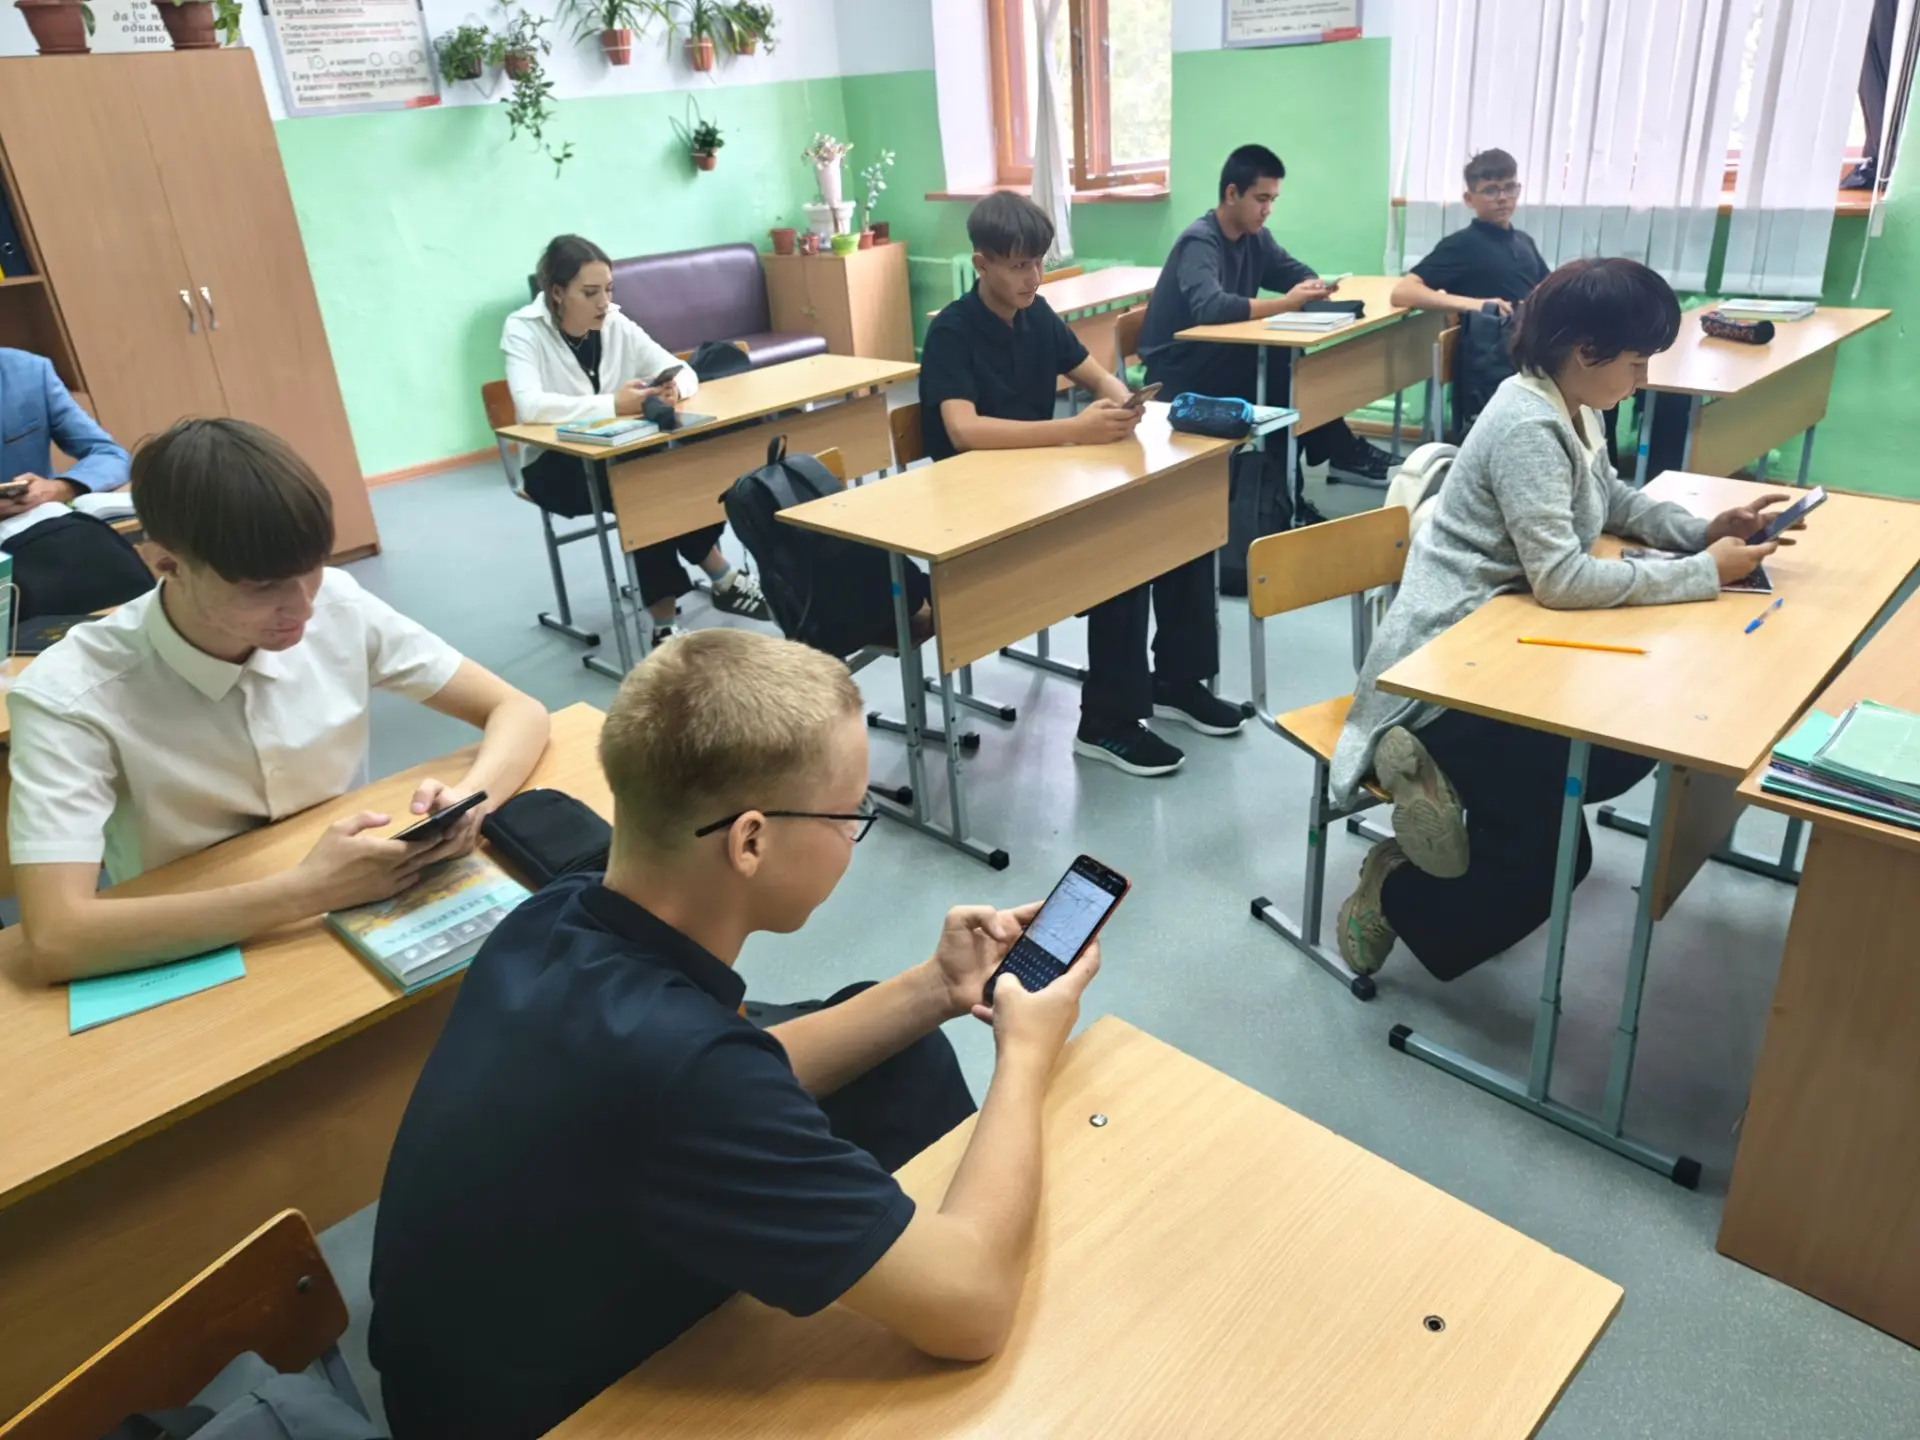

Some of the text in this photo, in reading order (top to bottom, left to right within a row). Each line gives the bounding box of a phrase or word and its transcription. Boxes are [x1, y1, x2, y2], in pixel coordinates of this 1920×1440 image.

[131, 2, 147, 10] но
[113, 11, 128, 21] да
[133, 36, 165, 44] зато
